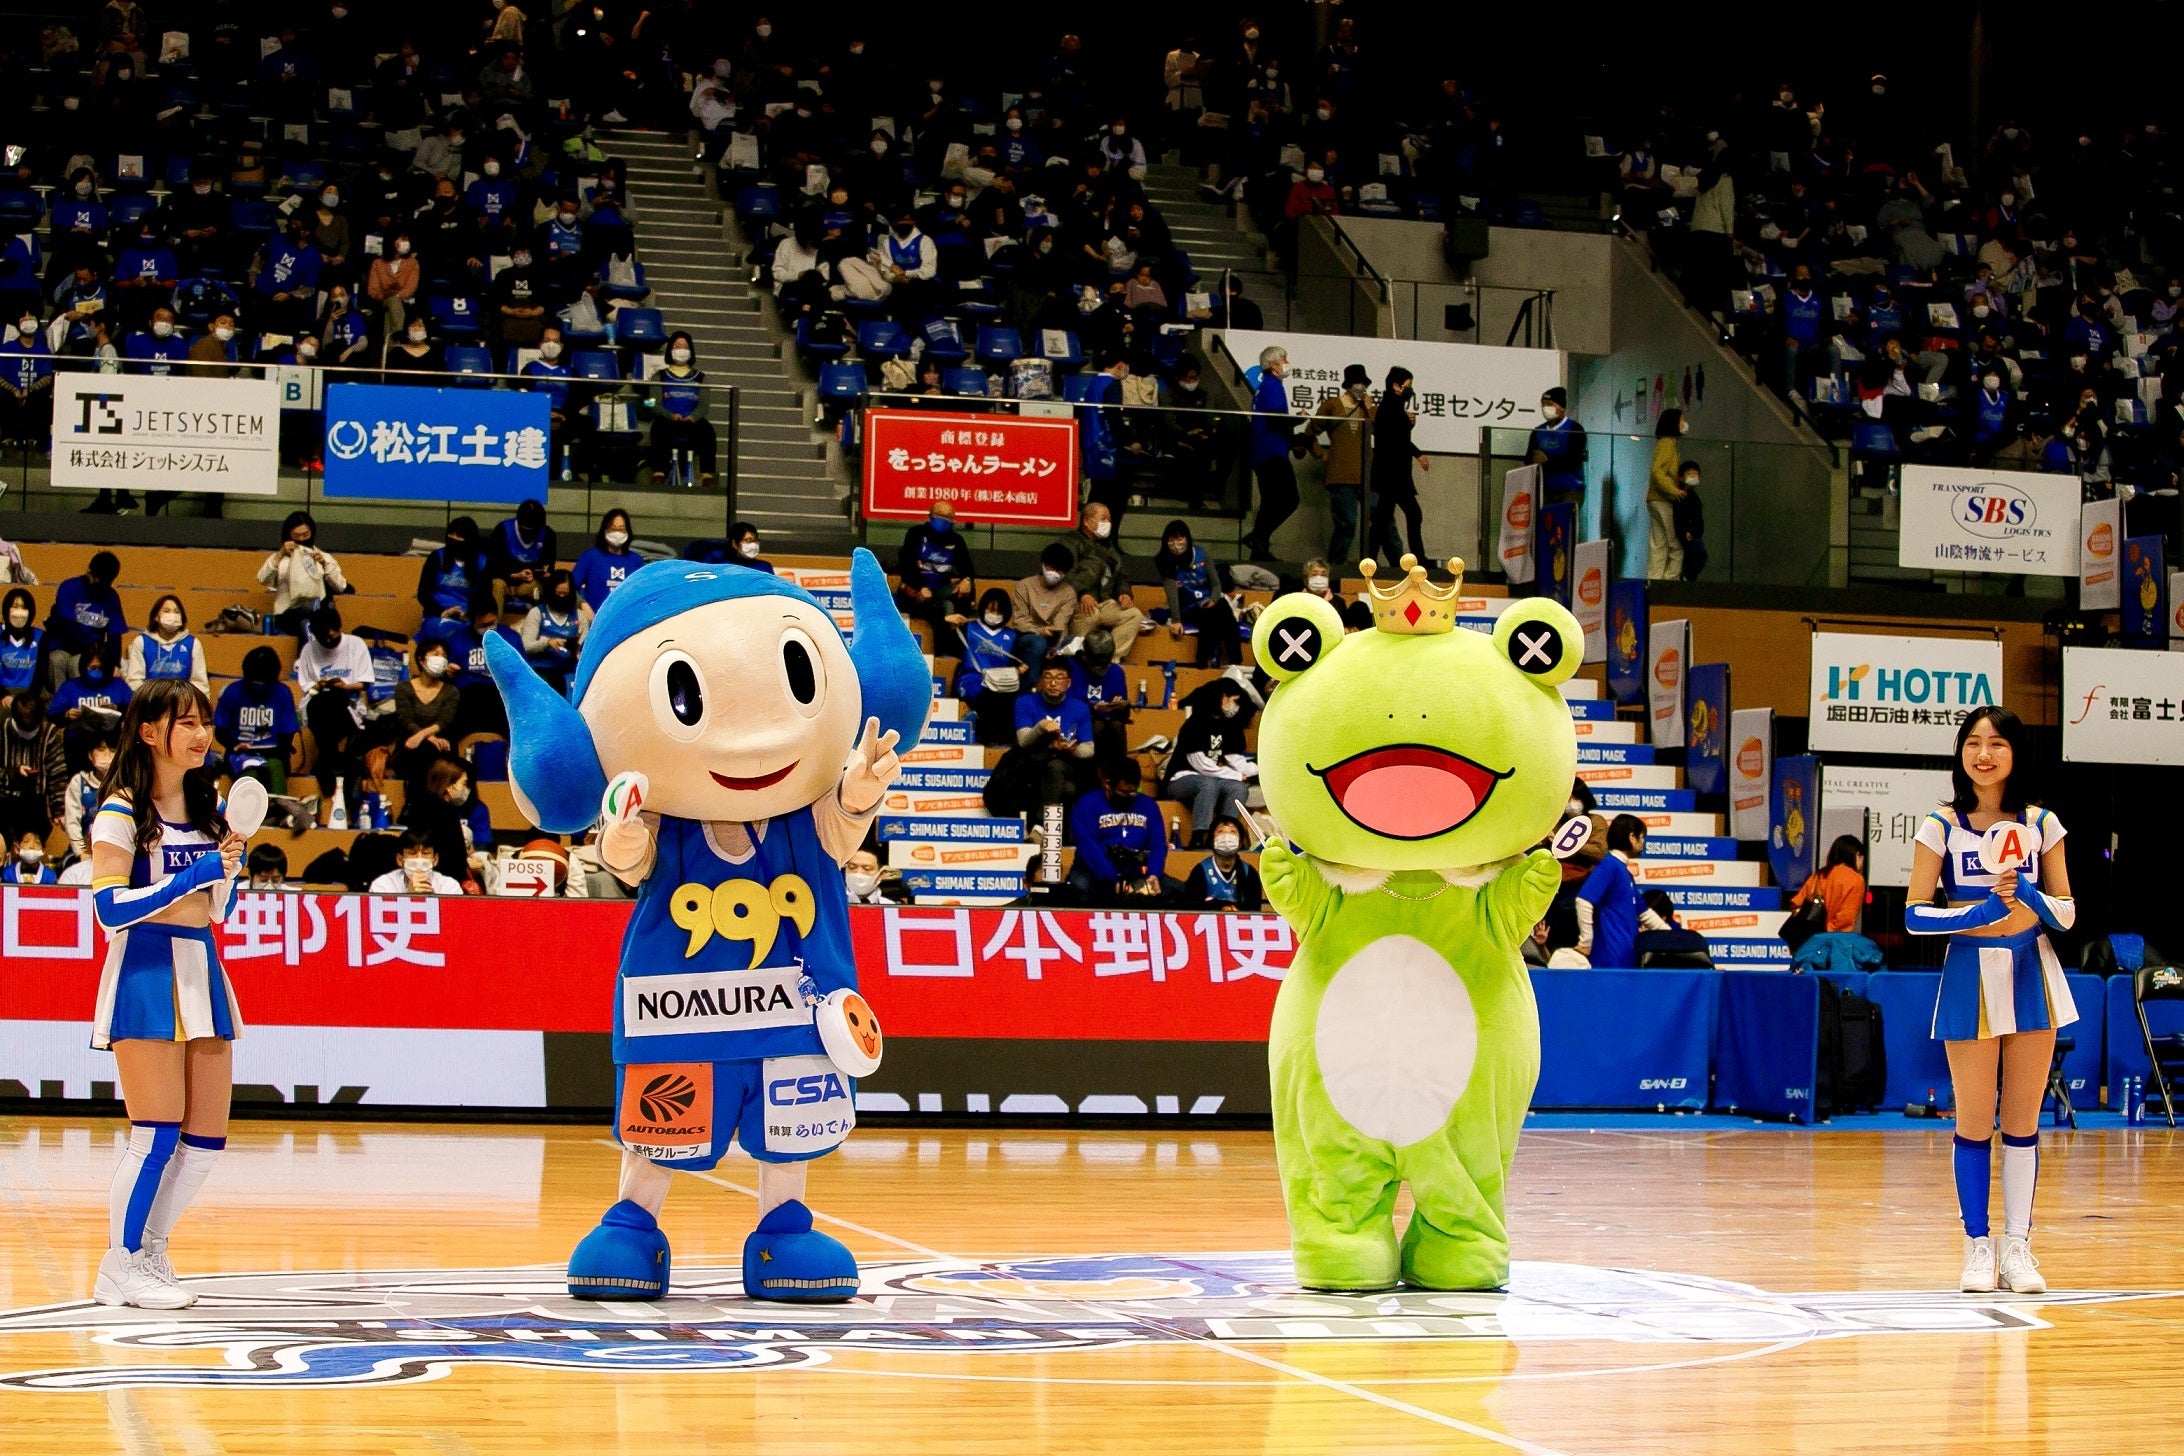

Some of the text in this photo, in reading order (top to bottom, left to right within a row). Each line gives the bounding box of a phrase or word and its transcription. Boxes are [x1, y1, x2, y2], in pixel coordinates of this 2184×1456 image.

[1292, 368, 1340, 382] 株式会社
[286, 383, 301, 401] B
[132, 410, 263, 435] JETSYSTEM
[370, 421, 547, 470] 松江土建
[70, 449, 230, 473] 株式会社 ジェットシステム
[1932, 483, 1985, 494] TRANSPORT
[1964, 495, 2026, 525] SBS
[1935, 543, 2047, 564] 山陰物流サービス
[1877, 668, 1994, 706] HOTTA
[1827, 705, 1970, 727] 堀田石油株式会
[2132, 697, 2184, 721] 富士
[940, 728, 966, 741] MAGIC
[623, 784, 643, 820] A
[910, 823, 949, 837] SHIMANE
[992, 825, 1020, 839] MAGIC
[1556, 820, 1588, 852] B
[1998, 829, 2024, 864] A
[935, 876, 975, 890] SHIMANE
[883, 907, 1293, 983] 日本郵便
[638, 983, 794, 1021] NOMURA
[768, 1072, 848, 1106] CSA
[626, 1123, 707, 1135] AUTOBACS
[768, 1119, 853, 1138] 積算 らいでん
[394, 1329, 1149, 1342] SHIMANE
